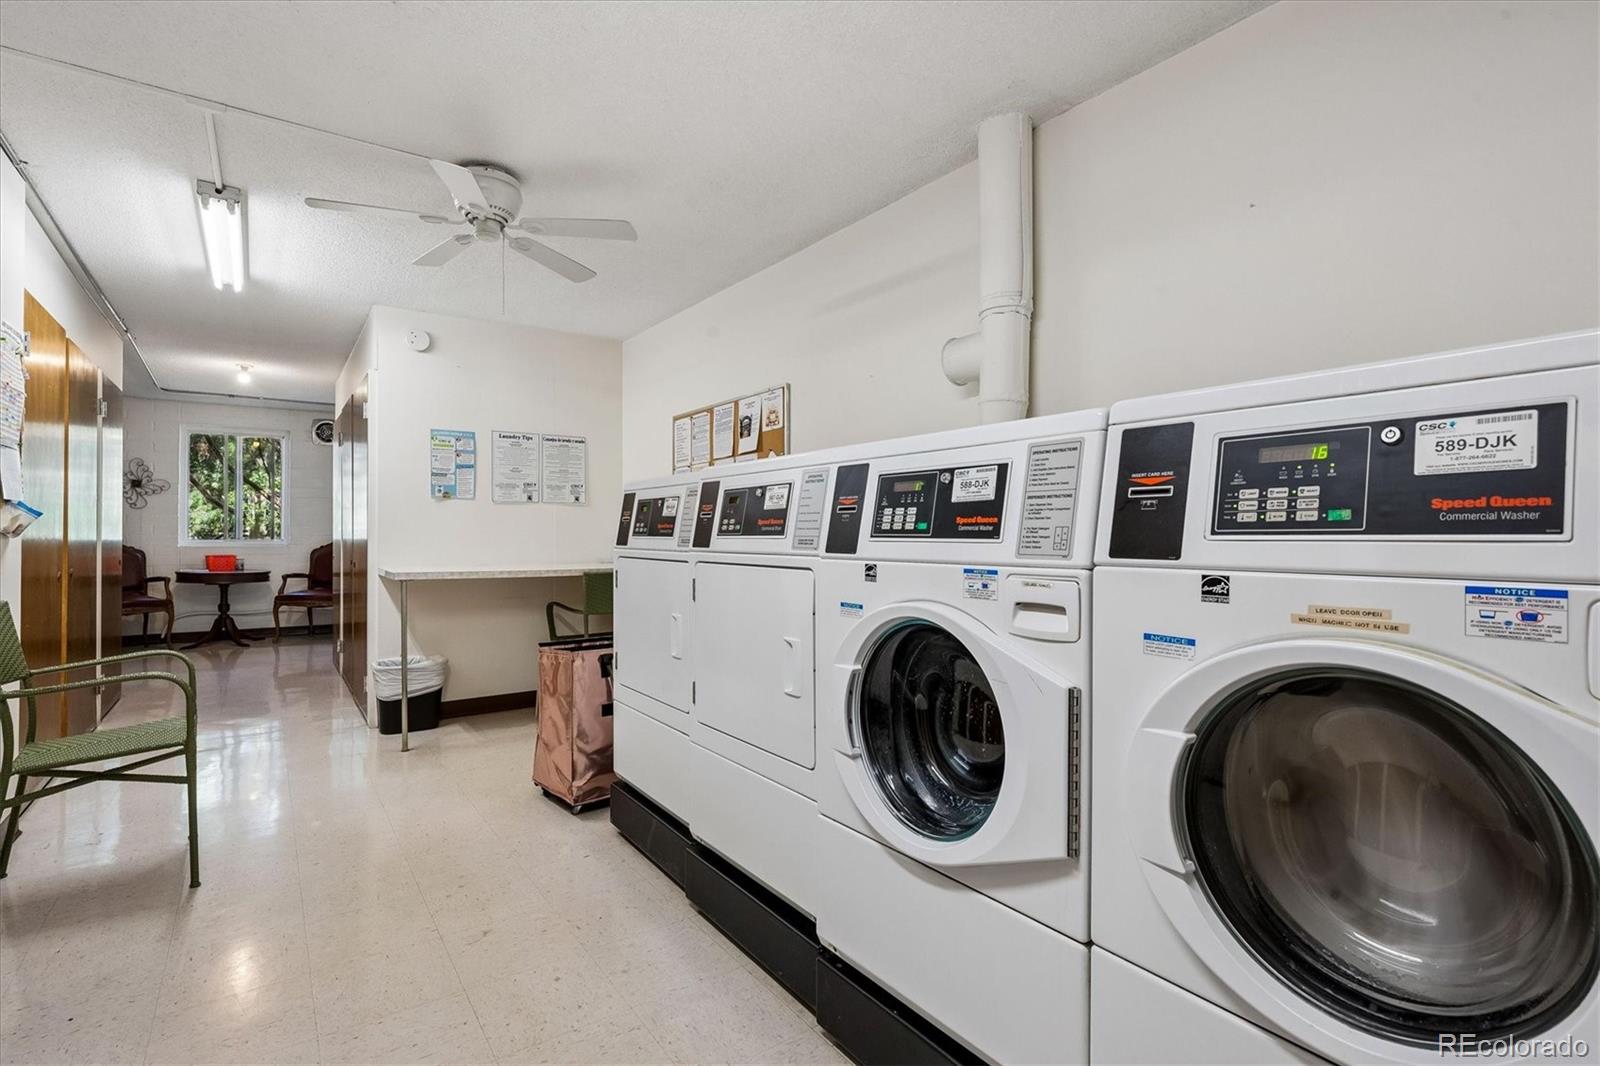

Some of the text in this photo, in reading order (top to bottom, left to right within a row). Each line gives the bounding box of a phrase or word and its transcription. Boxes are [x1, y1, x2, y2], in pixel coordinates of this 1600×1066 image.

[1418, 422, 1447, 431] CSC
[1434, 434, 1518, 453] 589-DJK
[1311, 445, 1328, 460] 16
[960, 480, 990, 489] 588-DJK
[1430, 496, 1552, 511] Speed Queen
[956, 516, 976, 524] Speed
[1439, 510, 1541, 521] Commercial Washer
[1494, 588, 1536, 596] NOTICE
[1150, 635, 1188, 645] NOTICE
